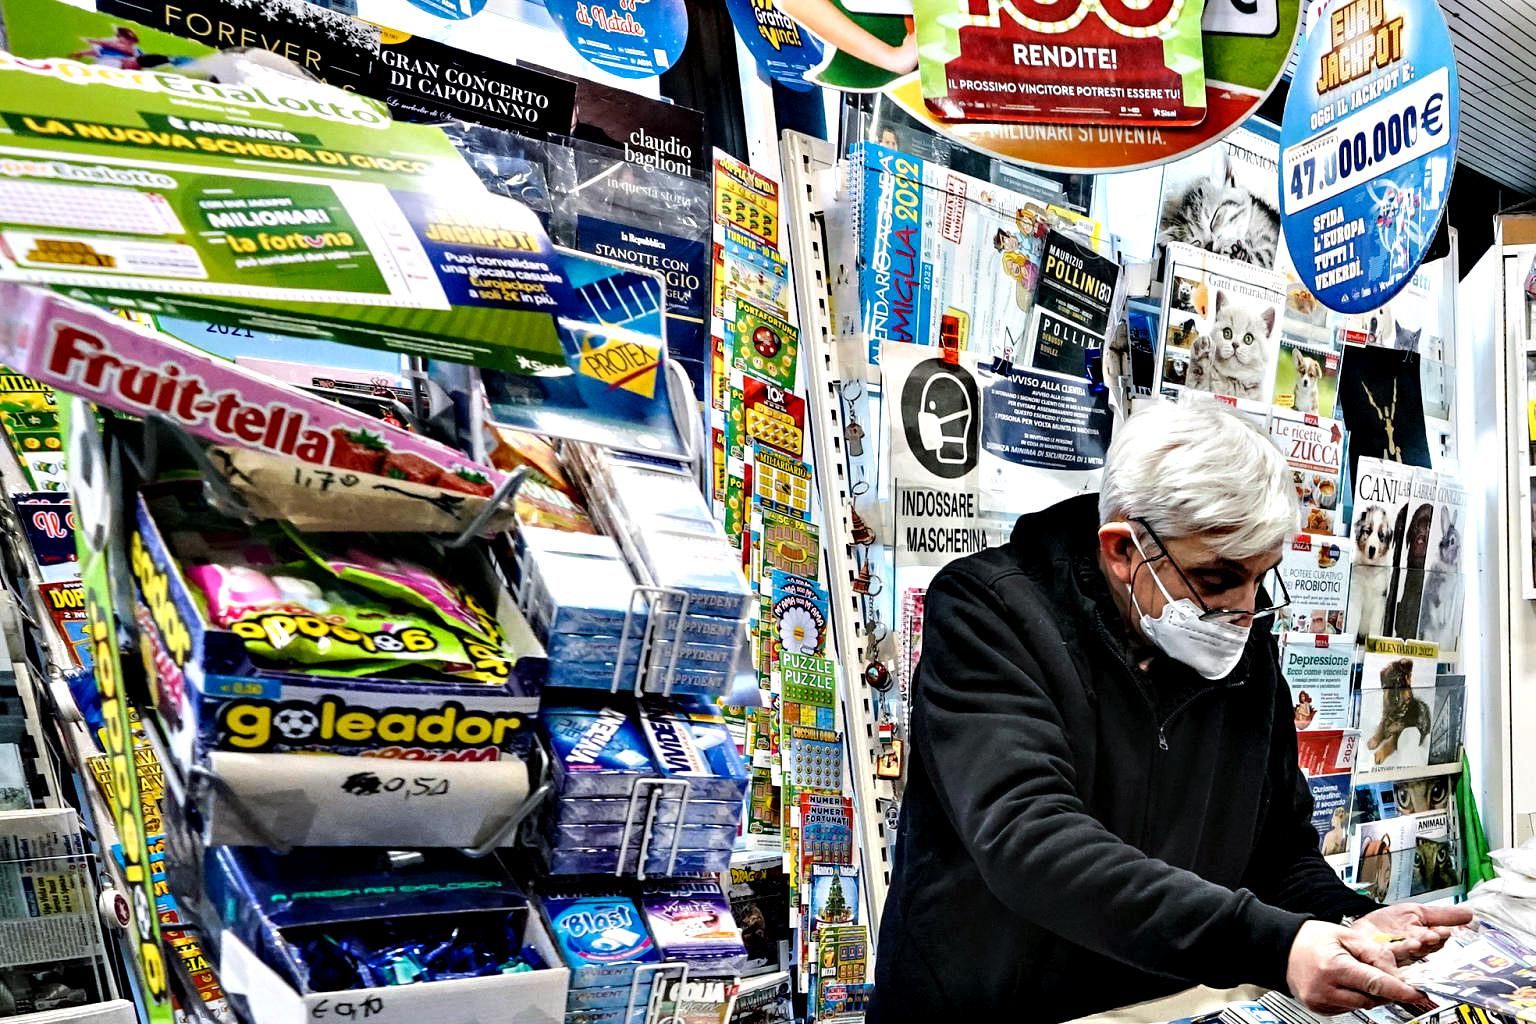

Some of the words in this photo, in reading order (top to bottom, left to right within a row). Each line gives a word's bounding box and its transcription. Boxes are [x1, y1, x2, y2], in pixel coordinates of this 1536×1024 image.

[594, 8, 645, 37] Natale
[1012, 43, 1118, 70] RENDITE!
[1316, 17, 1403, 95] JACKPOT
[382, 50, 439, 79] GRAN
[445, 68, 549, 110] CONCERTO
[959, 80, 1017, 93] PROSSIMO
[1018, 83, 1075, 97] VINCITORE
[1076, 86, 1124, 98] POTRESTI
[1127, 89, 1163, 100] ESSERE
[390, 70, 413, 88] DI
[418, 78, 538, 124] CAPODANNO
[1310, 107, 1334, 130] OGGI
[1350, 75, 1401, 110] JACKPOT
[629, 128, 692, 159] claudio
[624, 142, 692, 178] baglioni
[895, 158, 919, 224] 2022
[1313, 206, 1344, 233] SFIDA
[1314, 217, 1365, 253] L'EUROPA
[1049, 245, 1083, 269] MAURIZIO
[1314, 243, 1347, 270] TUTTI
[584, 343, 656, 378] PROTEX
[50, 324, 329, 465] Fruit-tella
[1291, 423, 1322, 443] ricette
[1290, 439, 1340, 466] ZUCCA
[901, 490, 975, 519] INDOSSARE
[906, 527, 988, 553] MASCHERINA
[1295, 579, 1340, 593] PROBIOTICI
[782, 652, 834, 674] PUZZLE
[1289, 653, 1349, 670] Depressione
[785, 670, 834, 689] PUZZLE
[811, 807, 845, 819] NUMERI
[1417, 817, 1446, 832] ANIMALI
[562, 906, 631, 938] Blast
